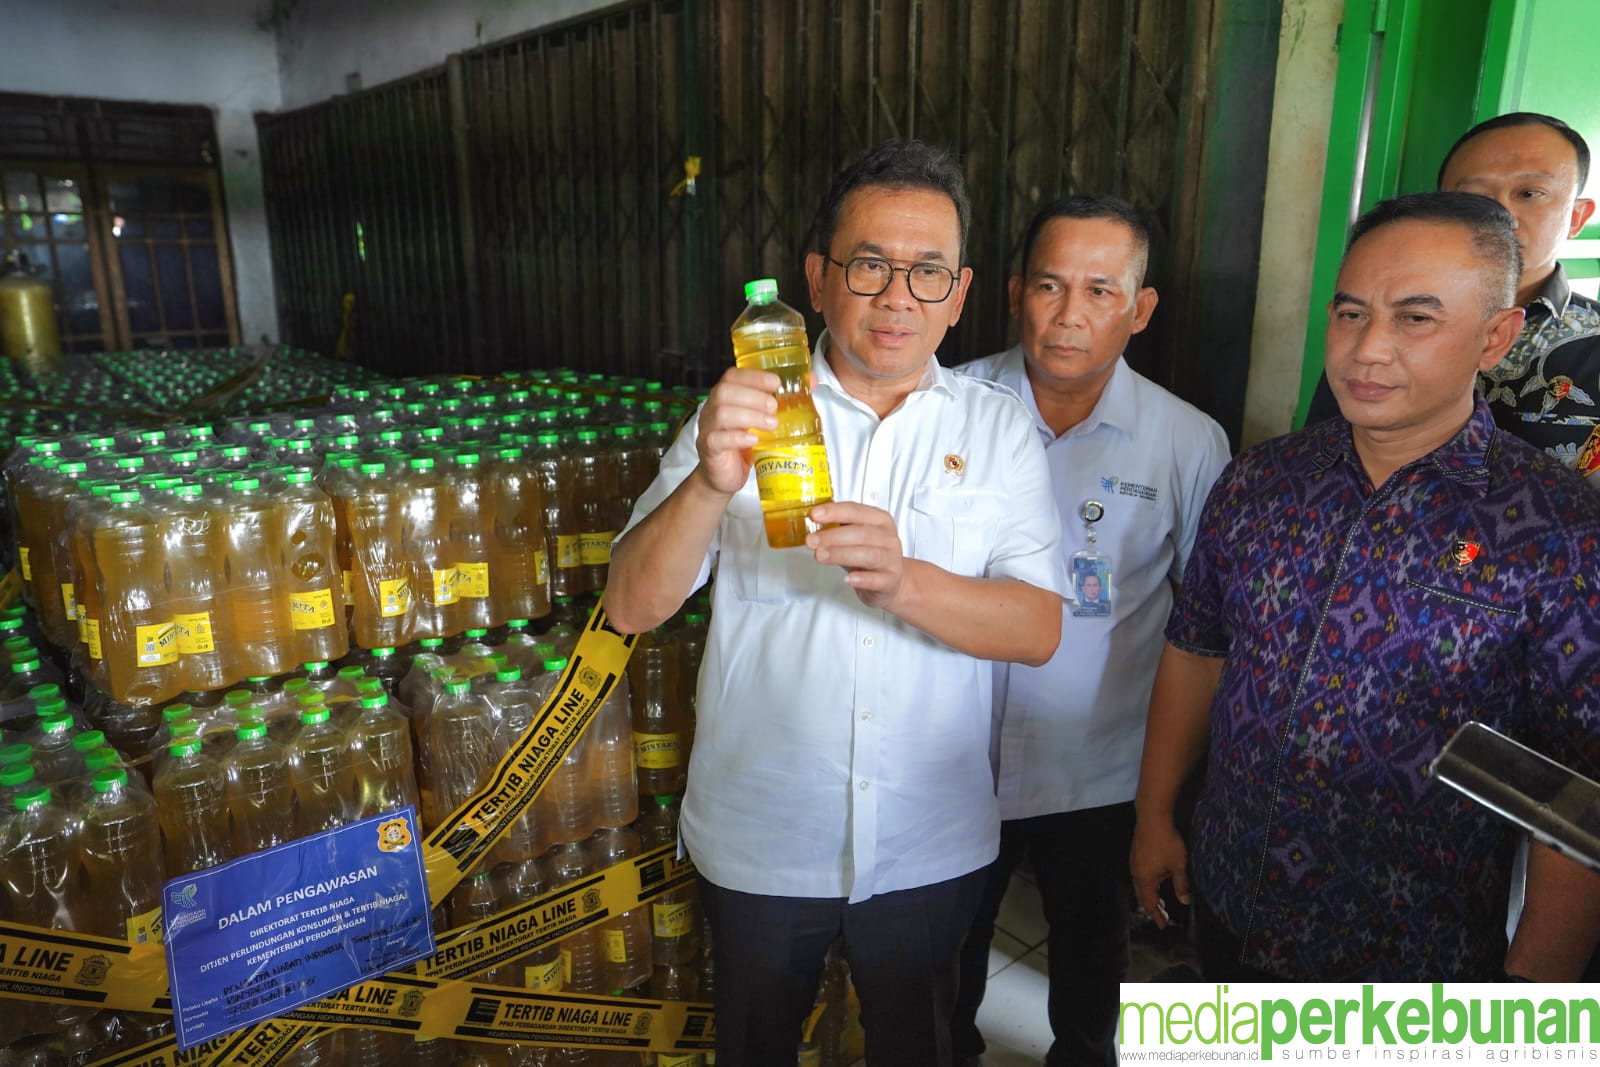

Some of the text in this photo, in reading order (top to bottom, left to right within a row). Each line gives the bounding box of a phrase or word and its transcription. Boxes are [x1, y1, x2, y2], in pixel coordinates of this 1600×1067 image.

[472, 688, 584, 824] TERTIB NIAGA LINE
[533, 737, 561, 773] DIREKTORAT
[218, 865, 378, 930] DALAM PENGAWASAN
[249, 896, 355, 938] DIREKTORAT TERTIB NIAGA
[200, 893, 405, 973] DITJEN PERLINDUNGAN KONSUMEN & TERTIB NIAGA
[247, 938, 304, 967] KEMENTERIAN
[305, 916, 366, 943] PERDAGANGAN
[424, 936, 484, 970] TERTIB
[489, 915, 538, 945] NIAGA
[542, 898, 576, 923] LINE
[445, 948, 494, 972] PERDAGANGAN
[496, 932, 534, 952] DIREKTORAT
[536, 922, 557, 934] TERTIB
[558, 914, 577, 926] NIAGA
[13, 946, 74, 972] LINE
[31, 971, 61, 982] NIAGA
[341, 1003, 367, 1012] TERTIB
[367, 1006, 389, 1014] NIAGA
[354, 986, 398, 1006] LINE
[504, 1003, 555, 1021] TERTIB
[556, 1007, 600, 1025] NIAGA
[602, 1011, 633, 1027] LINE
